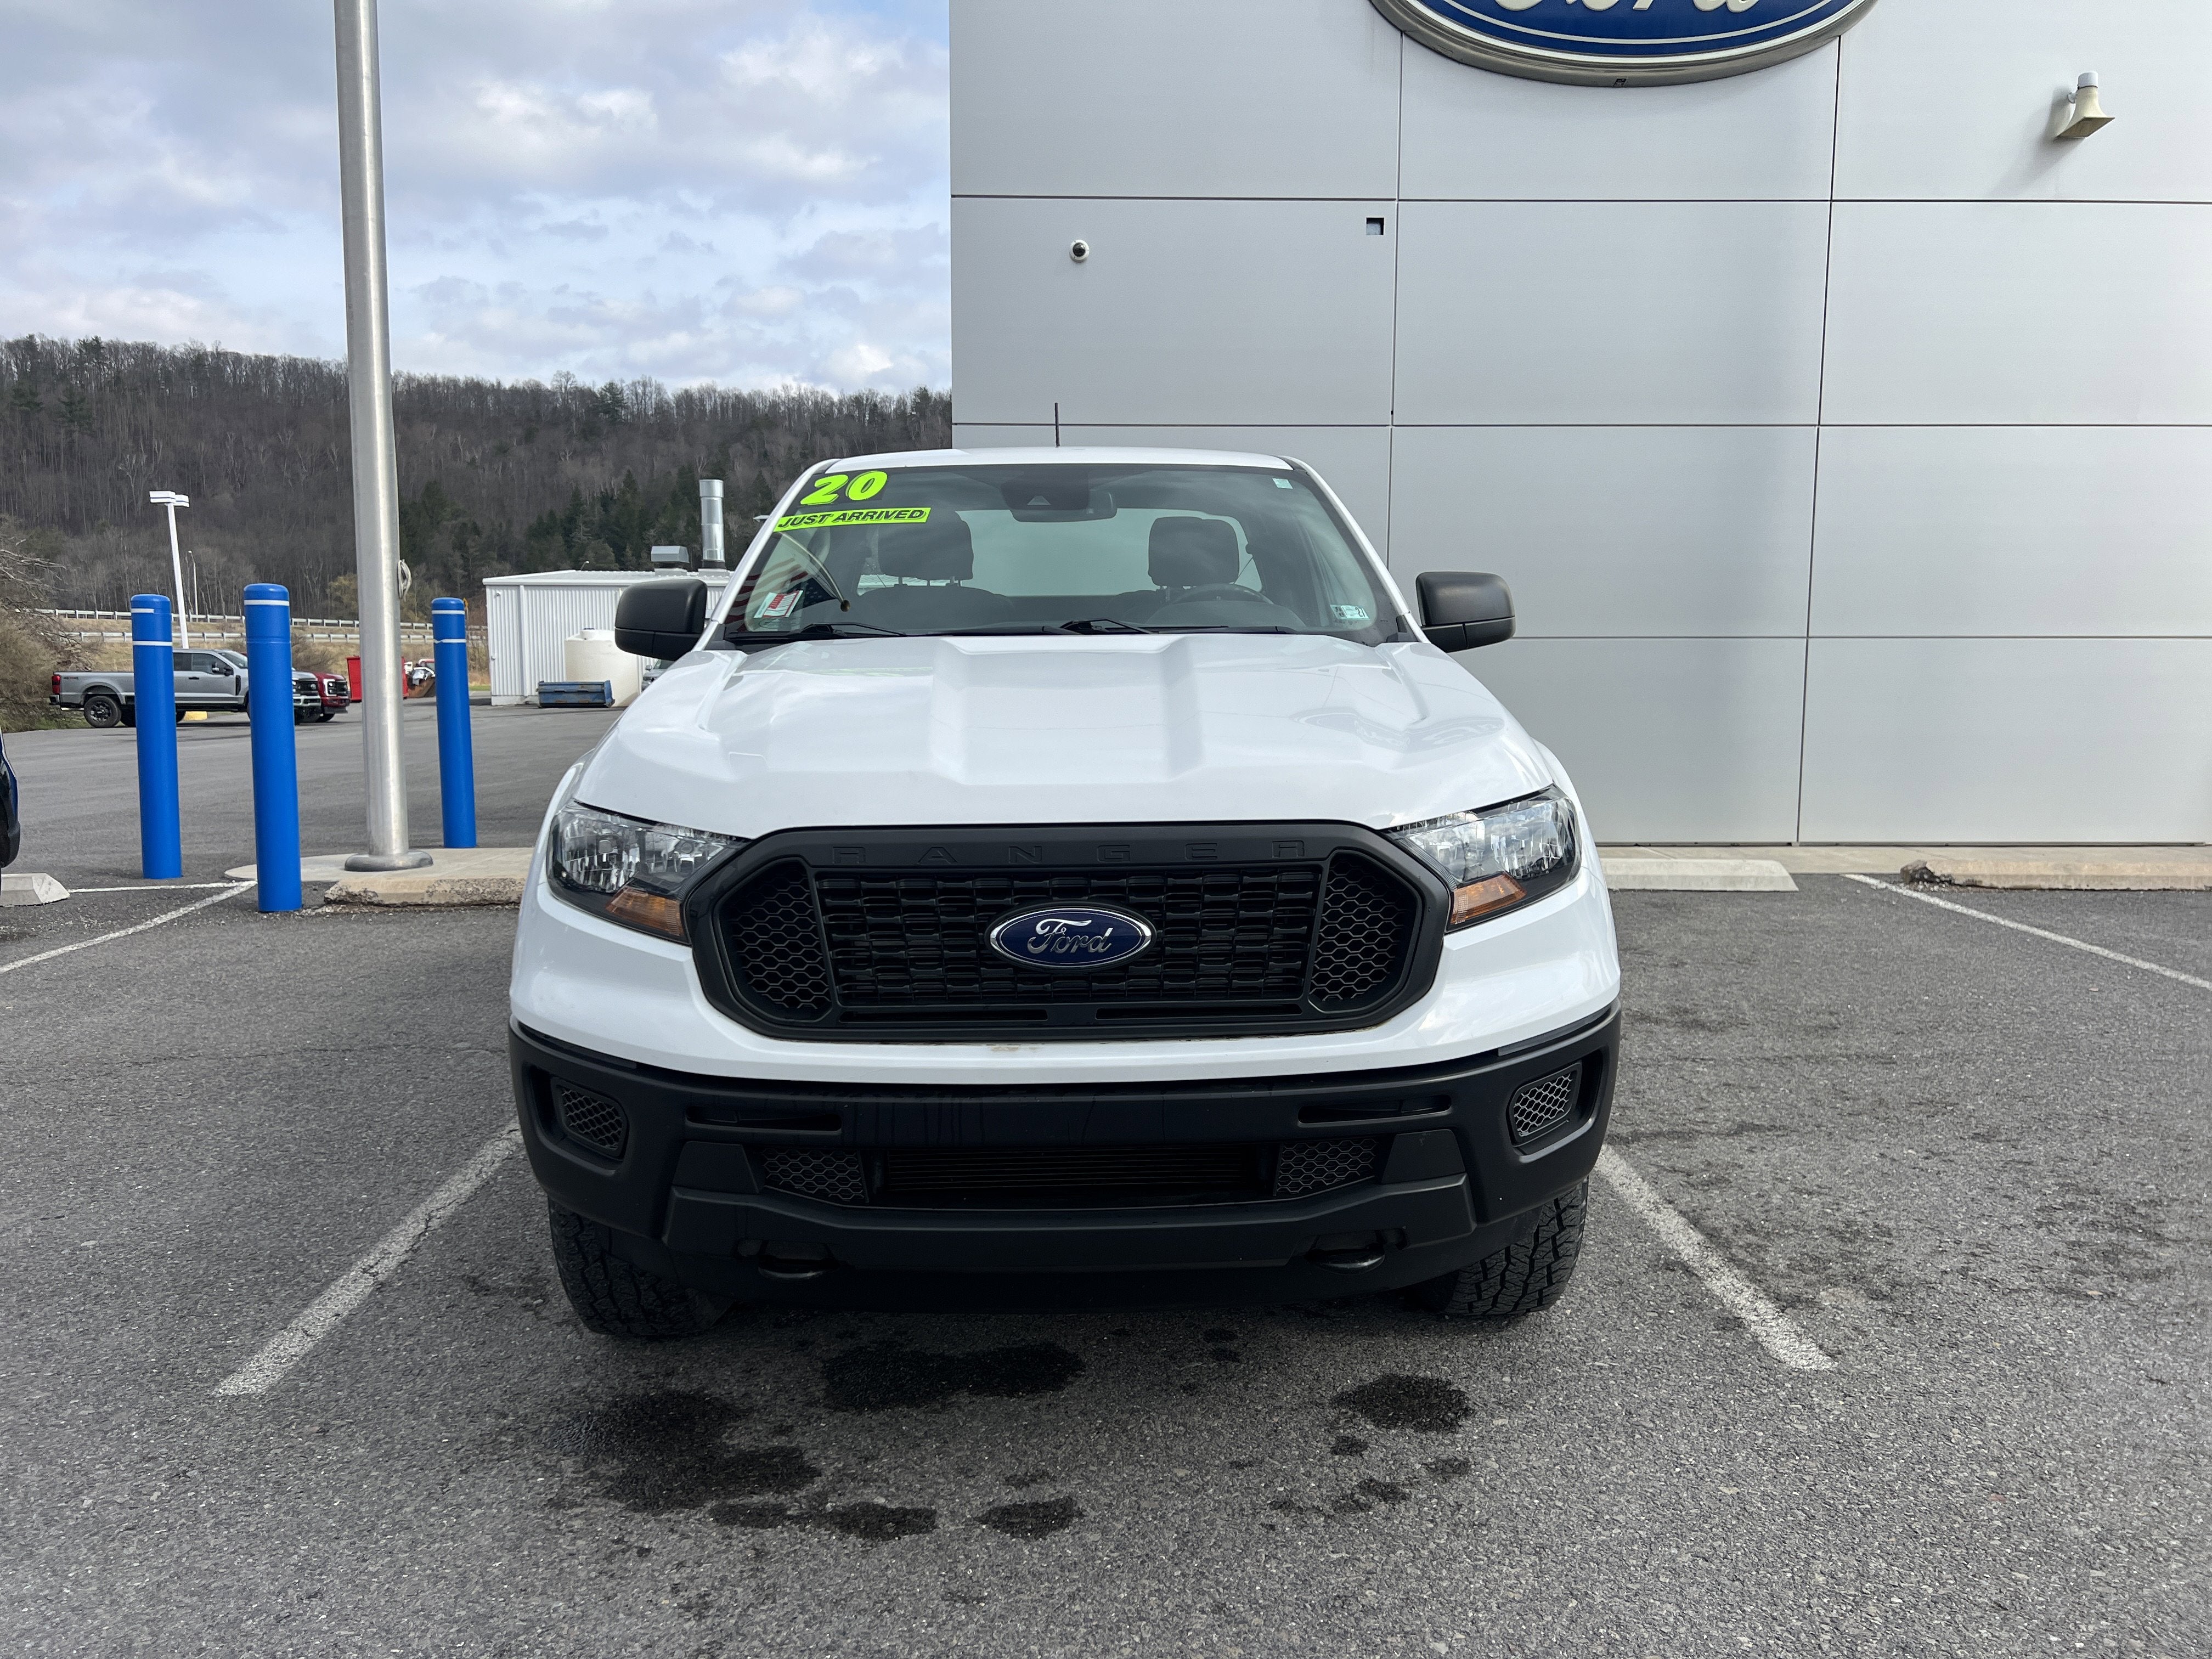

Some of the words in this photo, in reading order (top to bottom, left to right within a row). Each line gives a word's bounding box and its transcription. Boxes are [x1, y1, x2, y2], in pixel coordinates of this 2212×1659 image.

[800, 471, 887, 505] 20
[777, 513, 833, 528] JUST
[832, 510, 926, 522] ARRIVED
[832, 840, 1305, 864] RANGER
[1027, 918, 1113, 953] Ford
